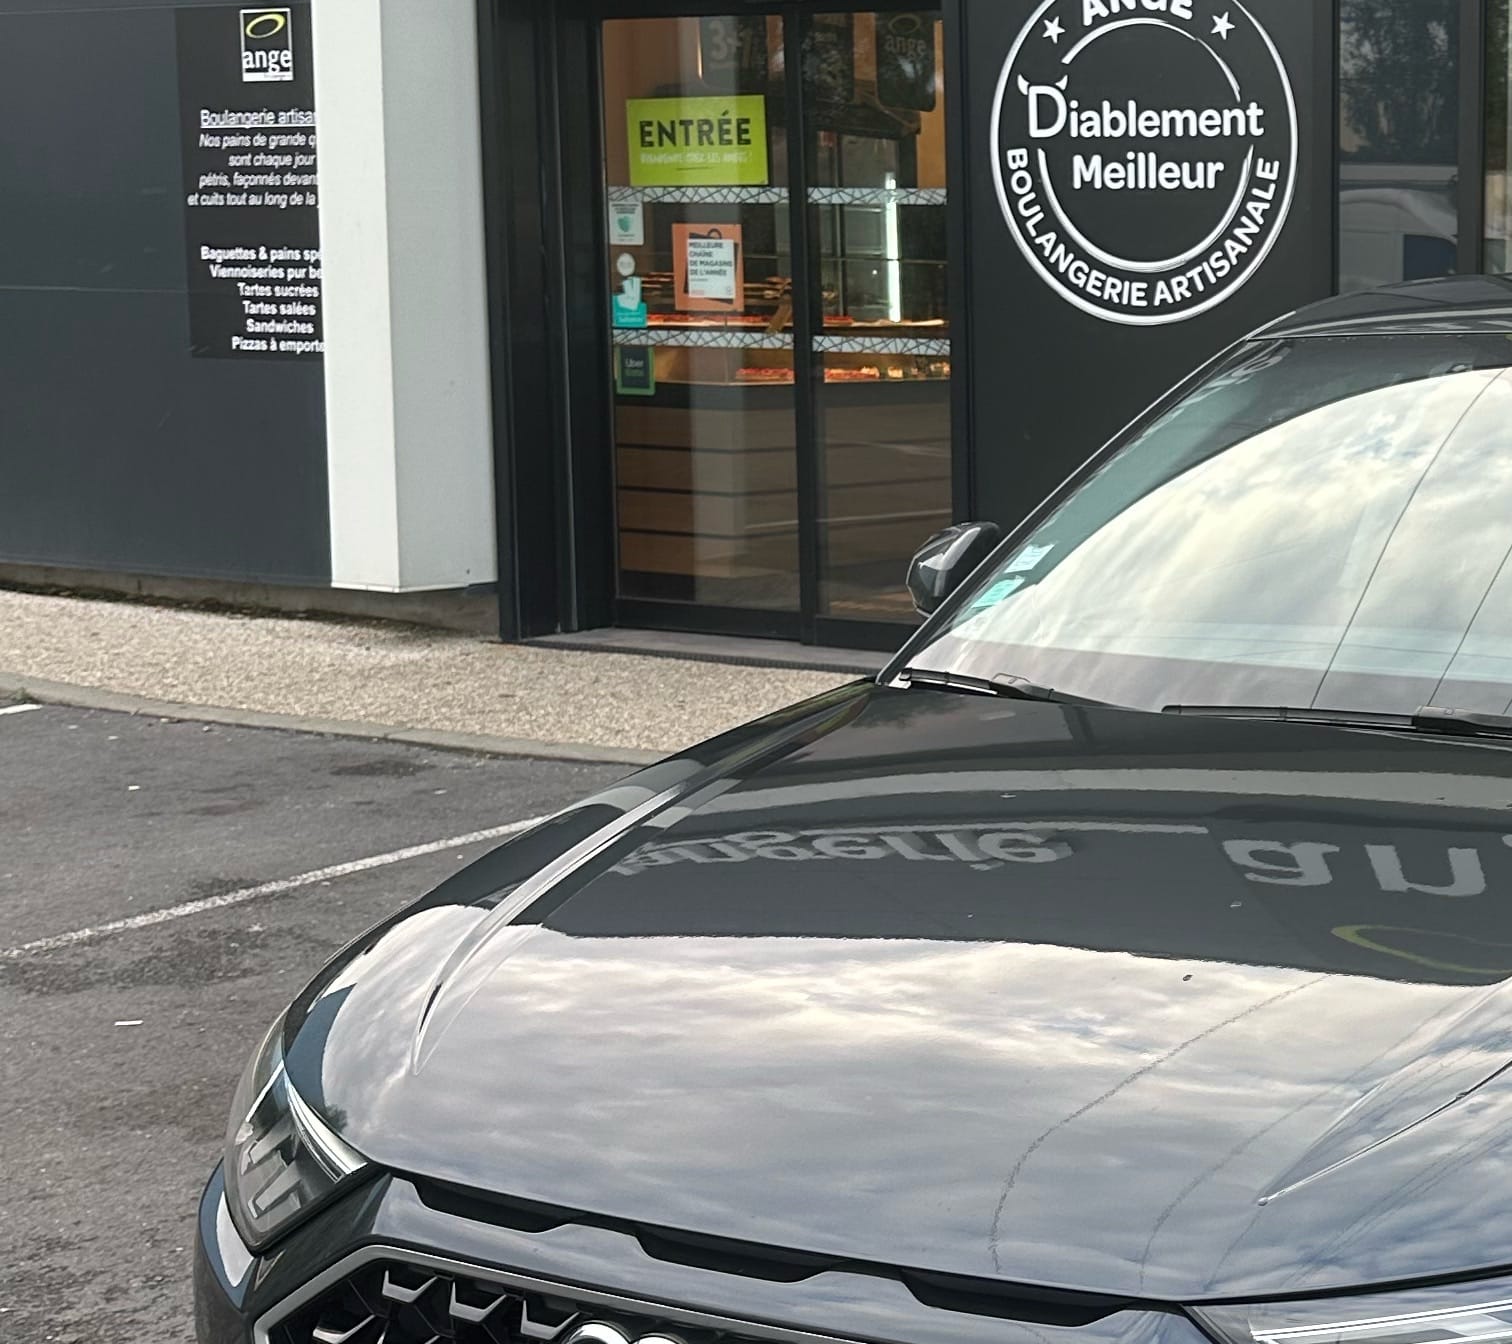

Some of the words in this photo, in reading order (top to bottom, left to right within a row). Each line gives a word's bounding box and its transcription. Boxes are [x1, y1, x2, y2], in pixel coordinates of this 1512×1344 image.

[243, 49, 293, 73] ange
[200, 109, 275, 128] Boulangerie
[1027, 86, 1264, 138] Diablement
[639, 110, 752, 148] ENTRÉE
[199, 134, 221, 147] Nos
[222, 132, 251, 149] pains
[253, 133, 267, 147] de
[268, 132, 306, 149] grande
[253, 153, 293, 169] chaque
[292, 151, 316, 169] jour
[1072, 152, 1224, 190] Meilleur
[187, 193, 198, 206] et
[248, 194, 263, 206] au
[264, 192, 288, 208] long
[289, 192, 304, 206] de
[305, 191, 316, 206] la
[1006, 148, 1148, 307] BOULANGERIE
[1153, 157, 1279, 306] ARTISANALE
[200, 245, 256, 263] Baguettes
[258, 246, 267, 260] &
[270, 246, 301, 263] pains
[209, 264, 284, 278] Viennoiseries
[287, 267, 307, 281] pur
[237, 282, 272, 296] Tartes
[274, 282, 319, 297] sucrées
[242, 300, 278, 314] Tartes
[279, 301, 316, 315] salées
[246, 318, 314, 333] Sandwiches
[232, 336, 268, 349] Pizzas
[270, 337, 277, 351] à
